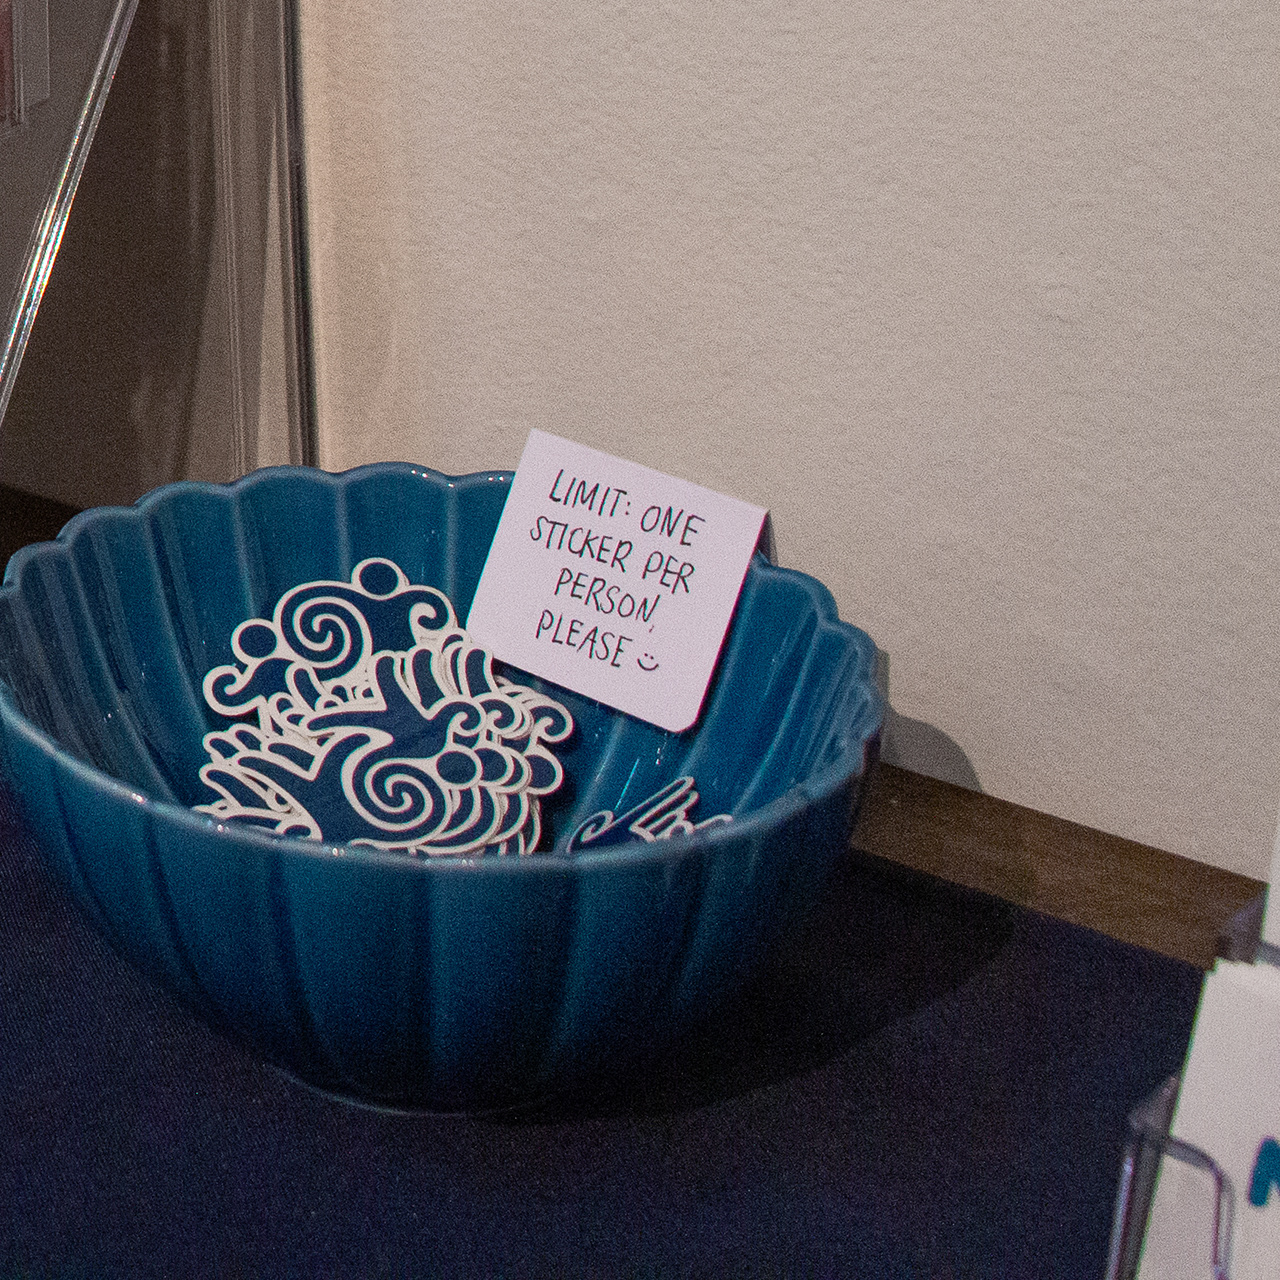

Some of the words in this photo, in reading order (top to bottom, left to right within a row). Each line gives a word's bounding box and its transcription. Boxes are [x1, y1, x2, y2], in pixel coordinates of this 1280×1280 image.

[548, 468, 631, 518] LIMIT:
[639, 505, 707, 547] ONE
[529, 515, 634, 574] STICKER
[641, 550, 696, 595] PER
[553, 567, 661, 634] PERSON,
[535, 608, 635, 669] PLEASE
